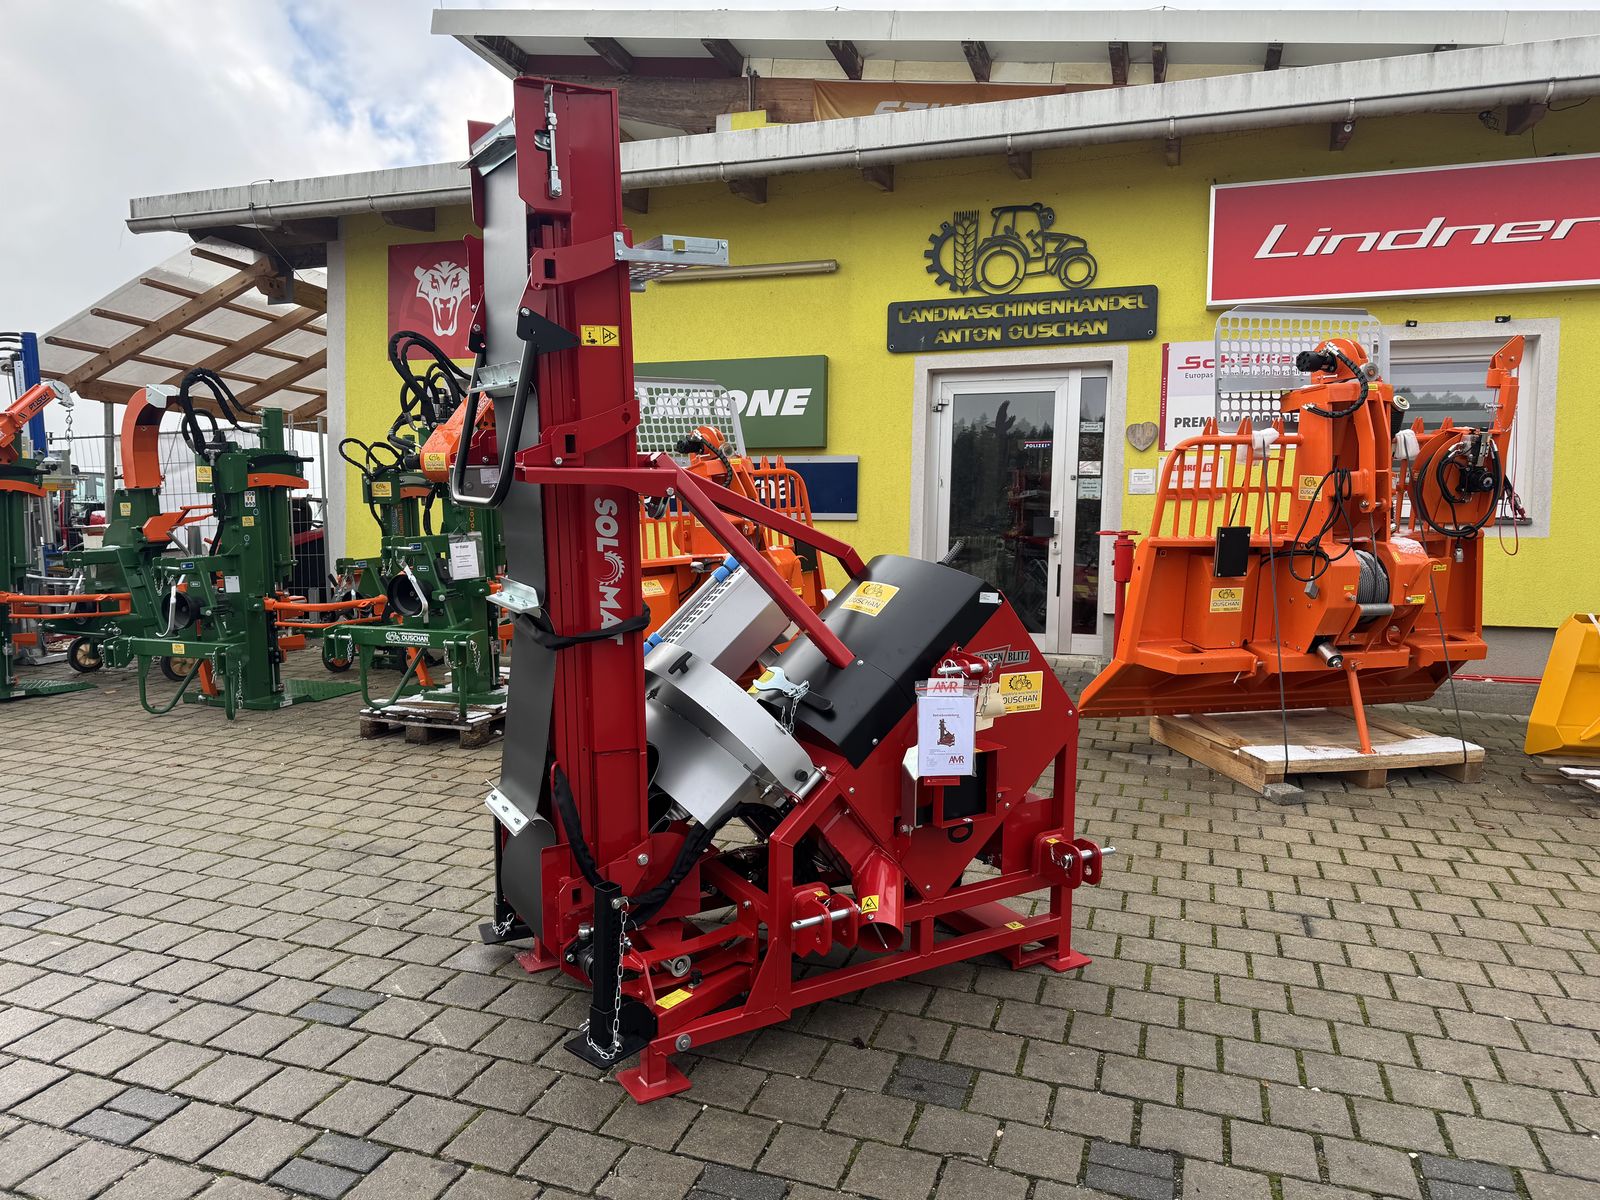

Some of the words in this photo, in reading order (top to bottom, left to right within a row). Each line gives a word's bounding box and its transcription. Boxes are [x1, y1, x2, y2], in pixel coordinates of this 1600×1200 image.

[1254, 216, 1600, 259] Lindner
[898, 293, 1149, 324] LANDMASCHINENHANDEL
[934, 325, 1002, 345] ANTON
[1007, 319, 1109, 340] OUSCHAN
[1177, 353, 1295, 370] Schäffe
[1184, 371, 1214, 380] Europas
[1008, 651, 1029, 661] BLITZ
[932, 681, 958, 693] AMR
[949, 755, 965, 764] AMR
